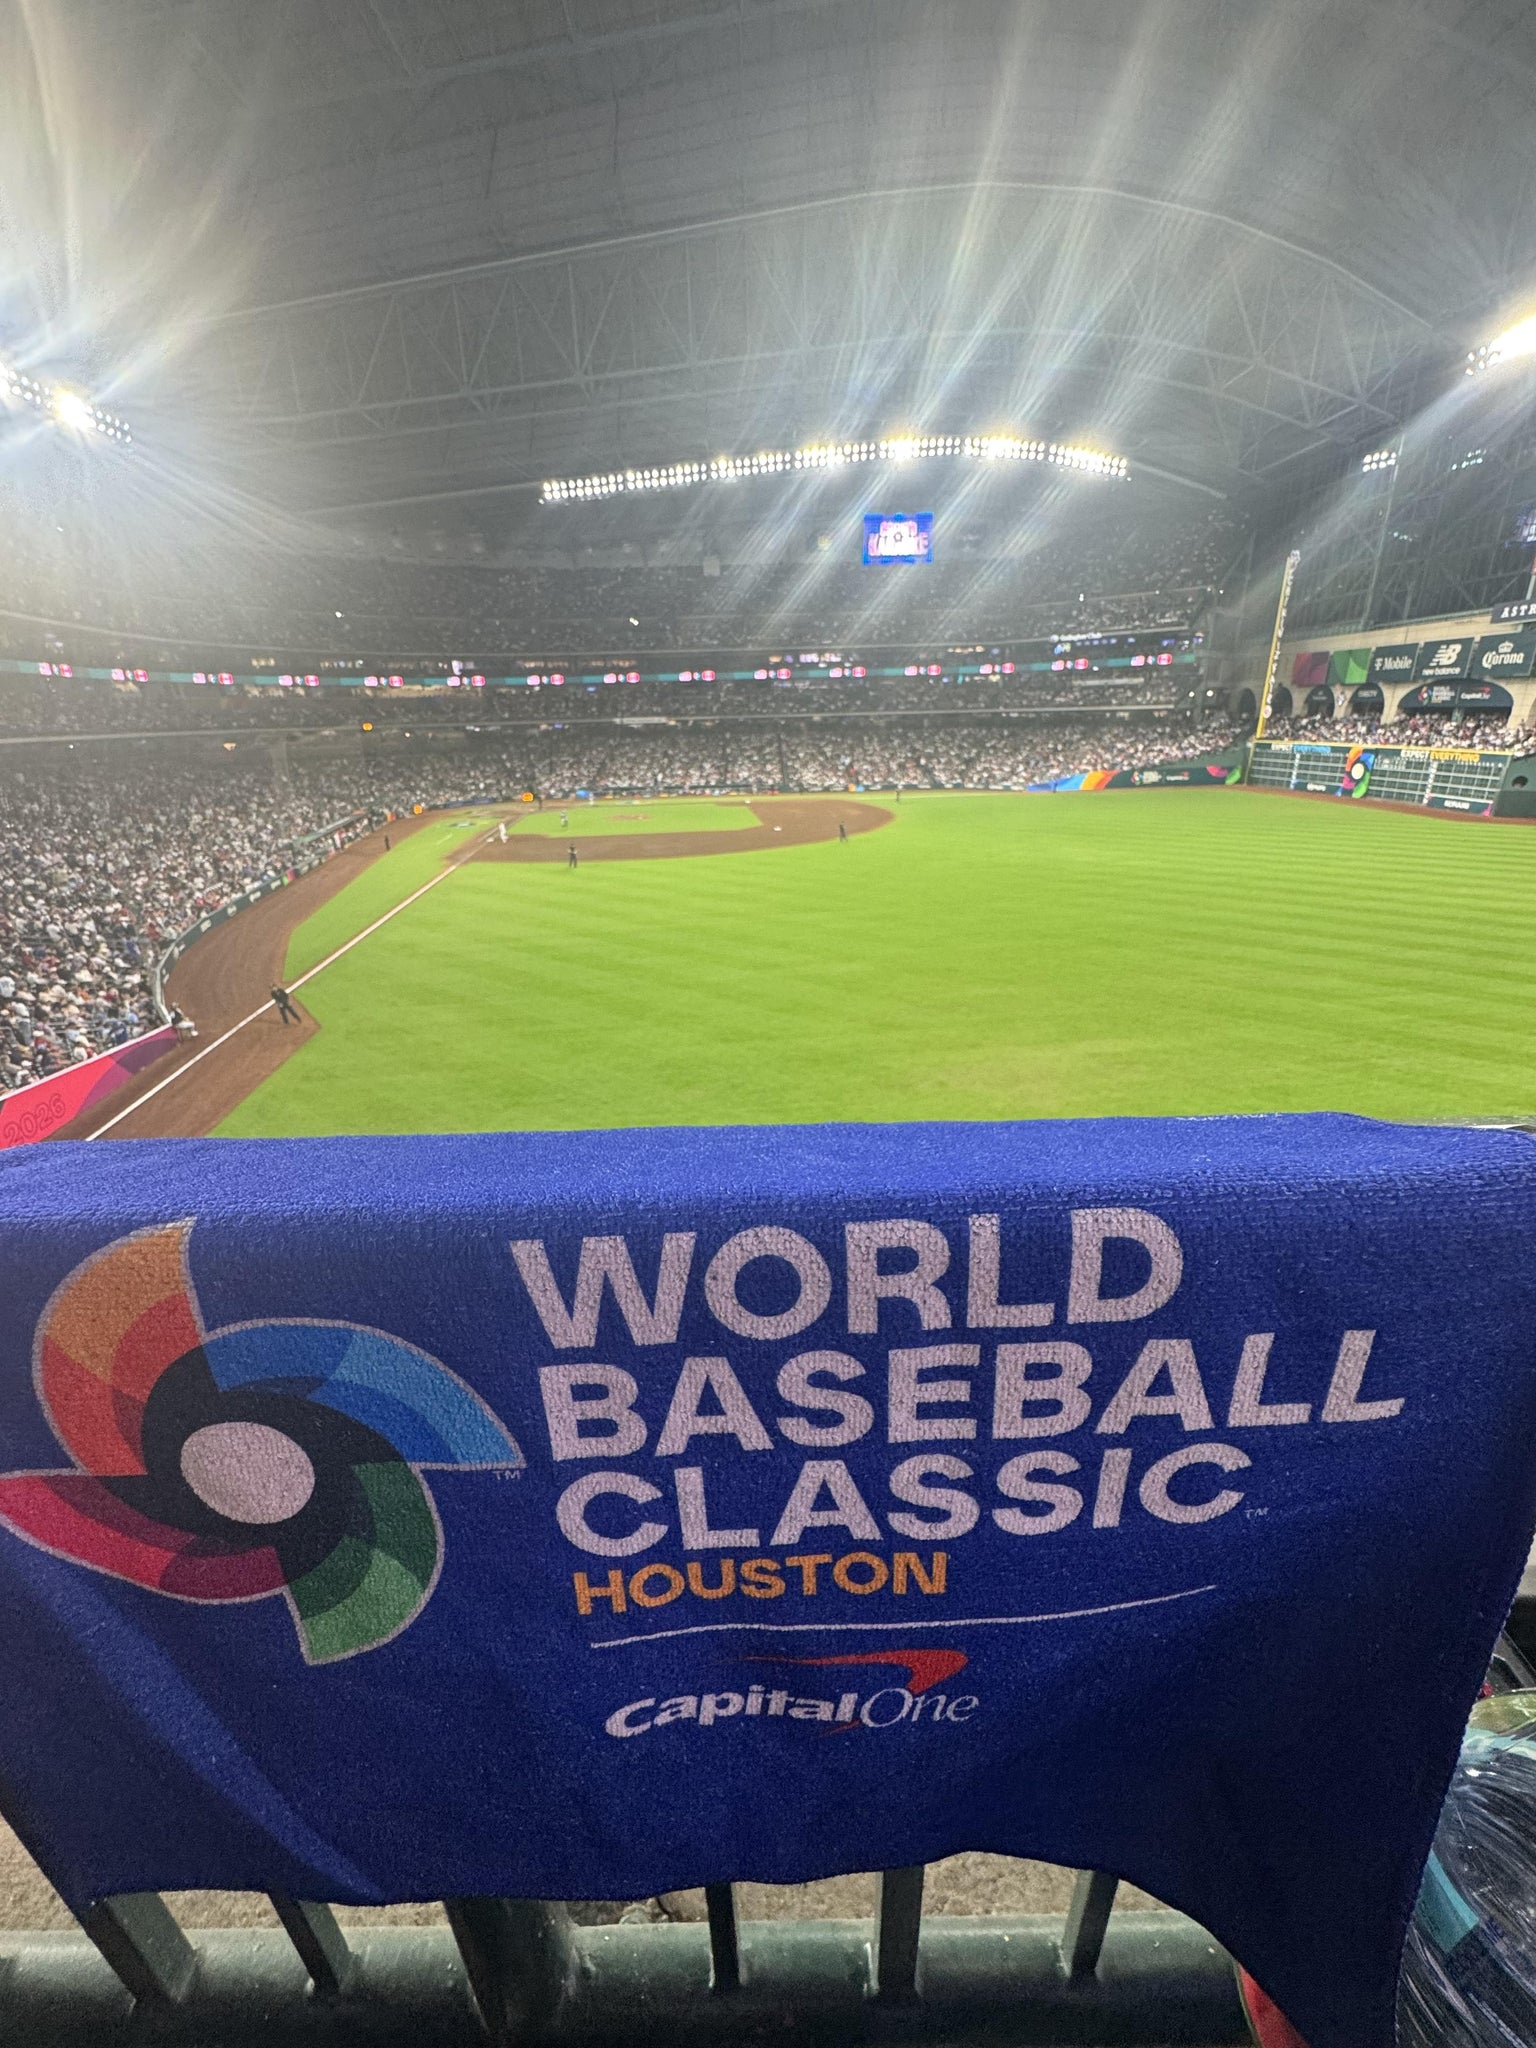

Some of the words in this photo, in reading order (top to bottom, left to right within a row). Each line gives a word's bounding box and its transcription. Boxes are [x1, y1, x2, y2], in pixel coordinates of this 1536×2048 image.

[1383, 656, 1412, 671] Mobile
[1422, 668, 1434, 676] new
[1435, 667, 1461, 675] balance
[1482, 651, 1525, 669] Corona
[1401, 749, 1430, 760] EXPECT
[3, 1092, 66, 1147] 2026
[509, 1207, 1184, 1349] WORLD
[538, 1329, 1405, 1461] BASEBALL
[492, 1470, 520, 1480] TM
[555, 1442, 1253, 1557] CLASSIC
[573, 1551, 948, 1615] HOUSTON
